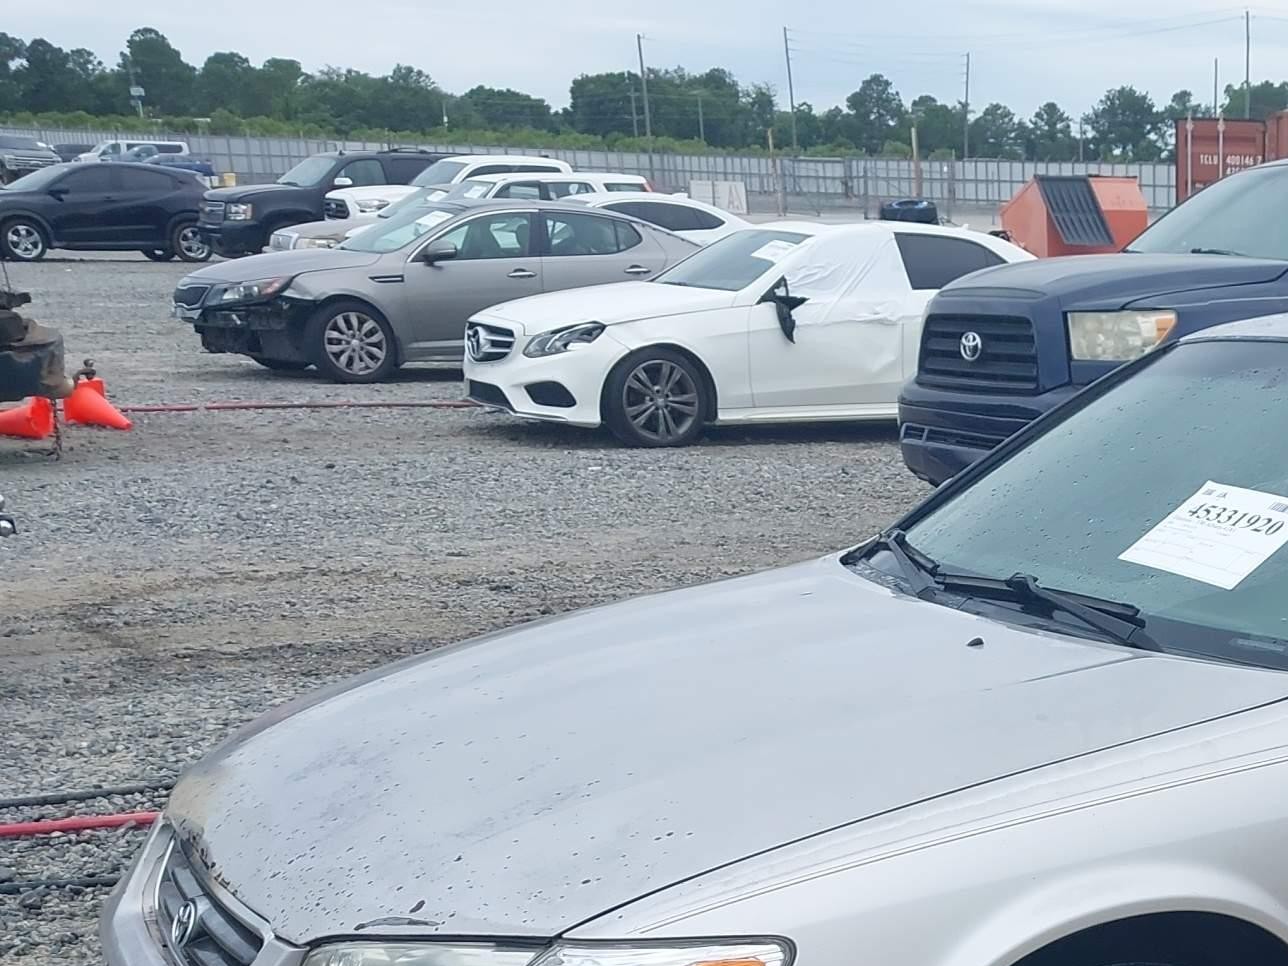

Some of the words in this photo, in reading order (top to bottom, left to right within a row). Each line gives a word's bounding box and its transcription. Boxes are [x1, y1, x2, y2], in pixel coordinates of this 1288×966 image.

[1200, 154, 1218, 165] TCLU
[1225, 154, 1254, 166] 400146
[1188, 502, 1285, 536] 45331920
